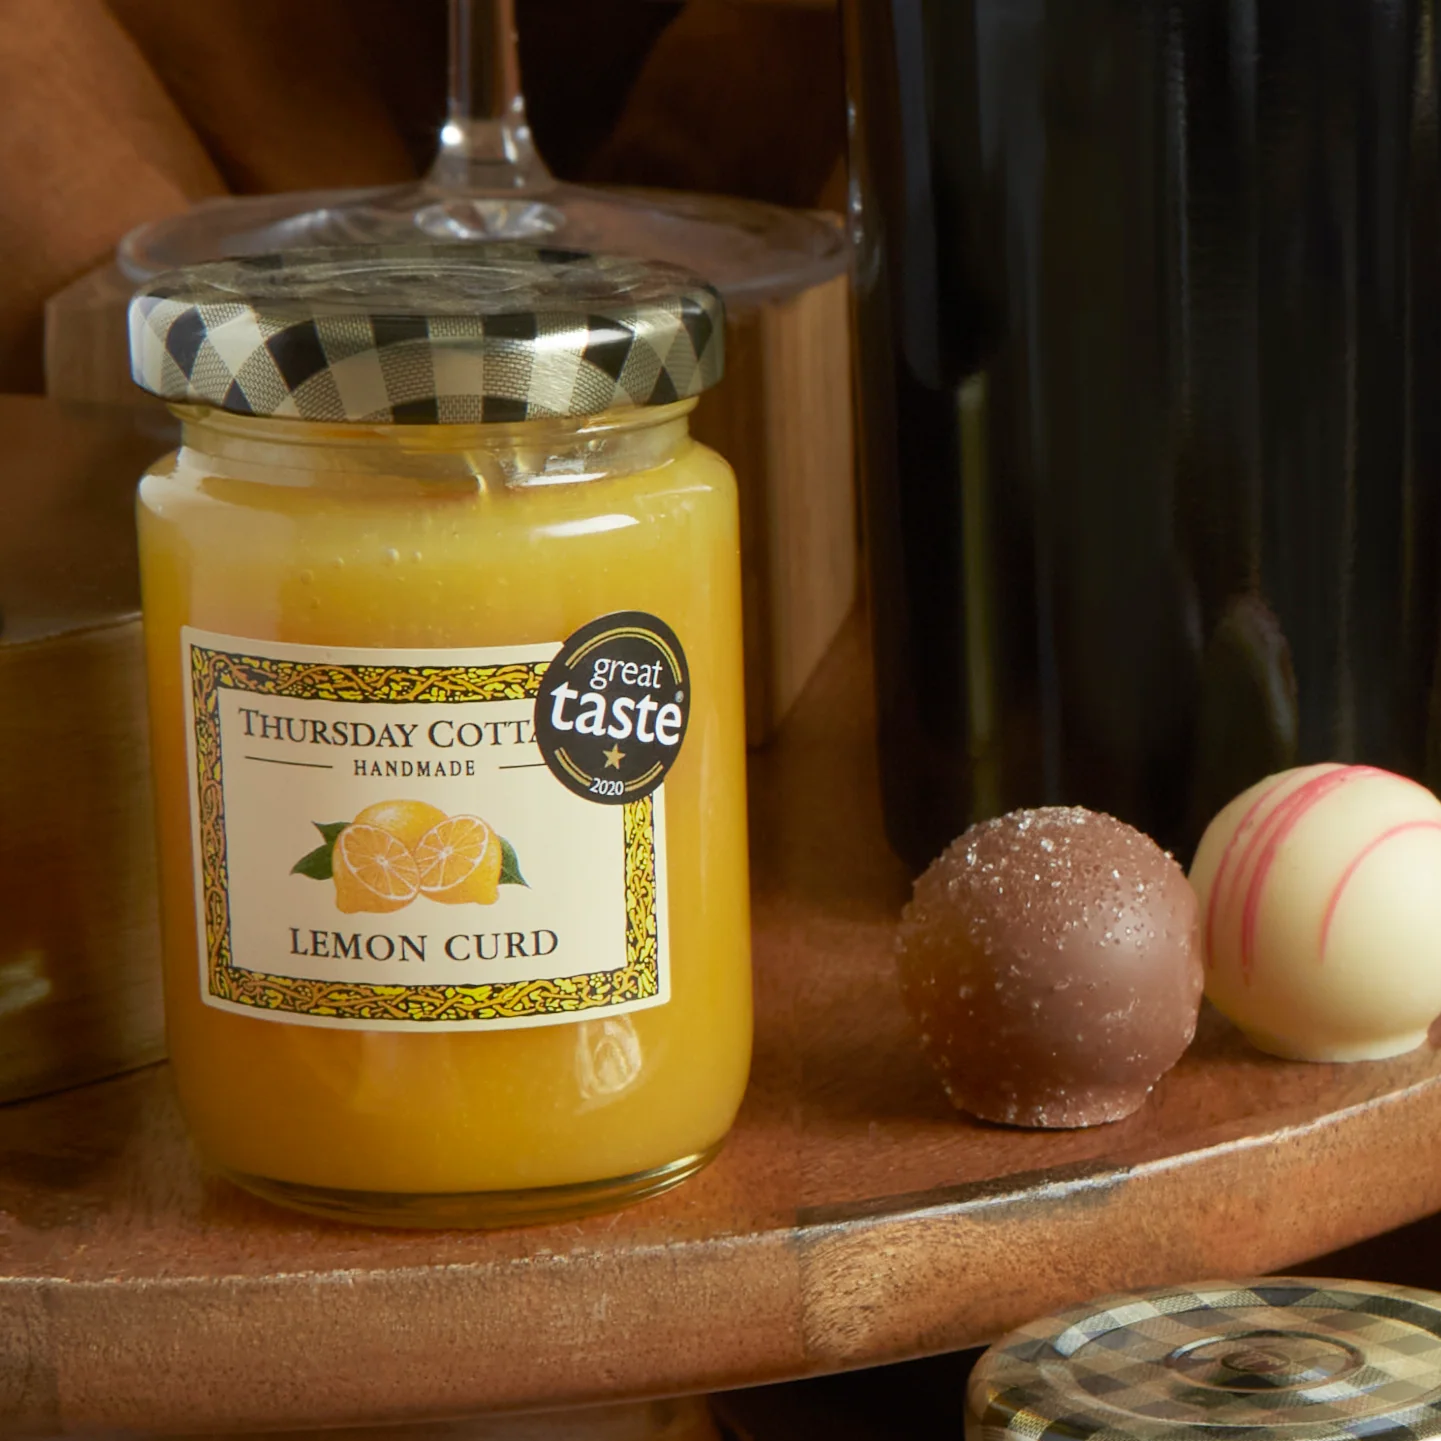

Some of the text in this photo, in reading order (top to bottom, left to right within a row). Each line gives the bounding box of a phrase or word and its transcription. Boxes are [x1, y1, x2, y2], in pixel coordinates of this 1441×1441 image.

[590, 658, 663, 690] great
[238, 708, 537, 748] THURSDAY COTT
[550, 681, 682, 746] taste
[353, 759, 475, 777] HANDMADE
[590, 778, 625, 796] 2020
[290, 927, 559, 962] LEMON CURD
